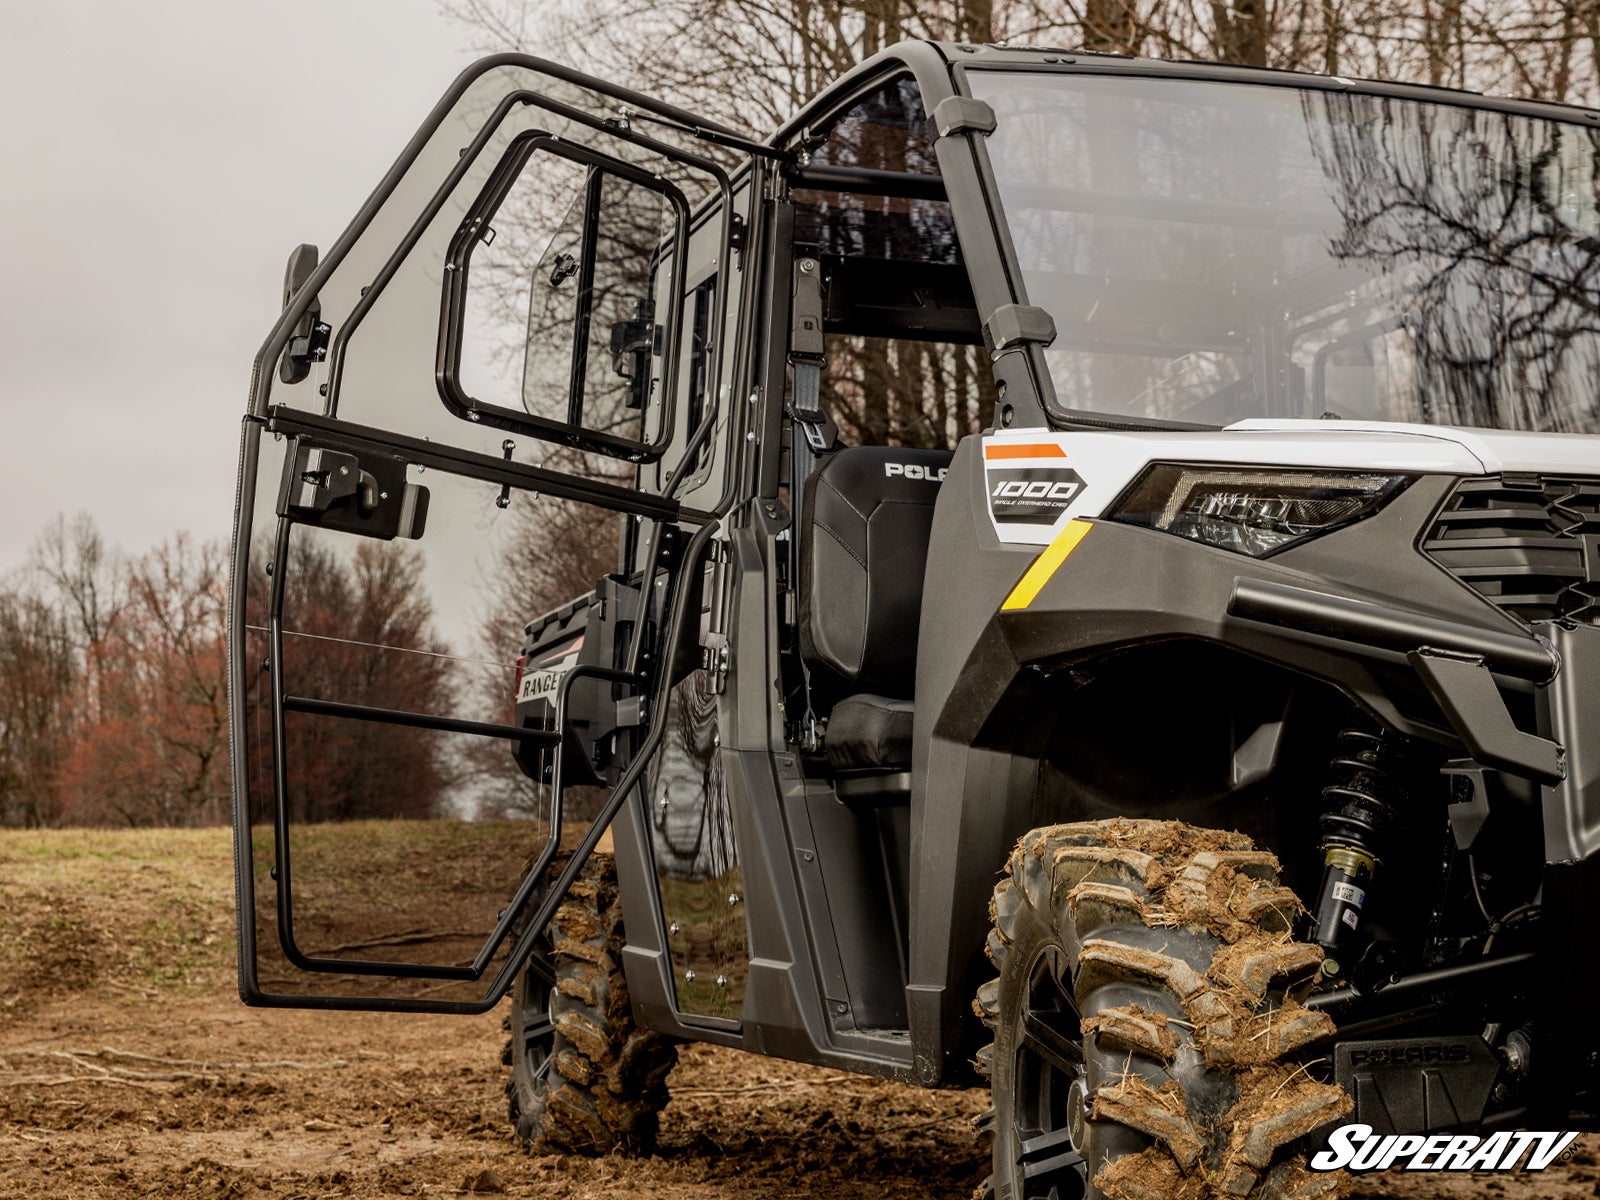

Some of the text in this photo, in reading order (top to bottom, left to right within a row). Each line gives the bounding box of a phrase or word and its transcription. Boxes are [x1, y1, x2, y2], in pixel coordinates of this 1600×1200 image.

[992, 481, 1079, 499] 1000
[523, 670, 566, 698] RANGE
[1350, 1044, 1470, 1065] POLARIS
